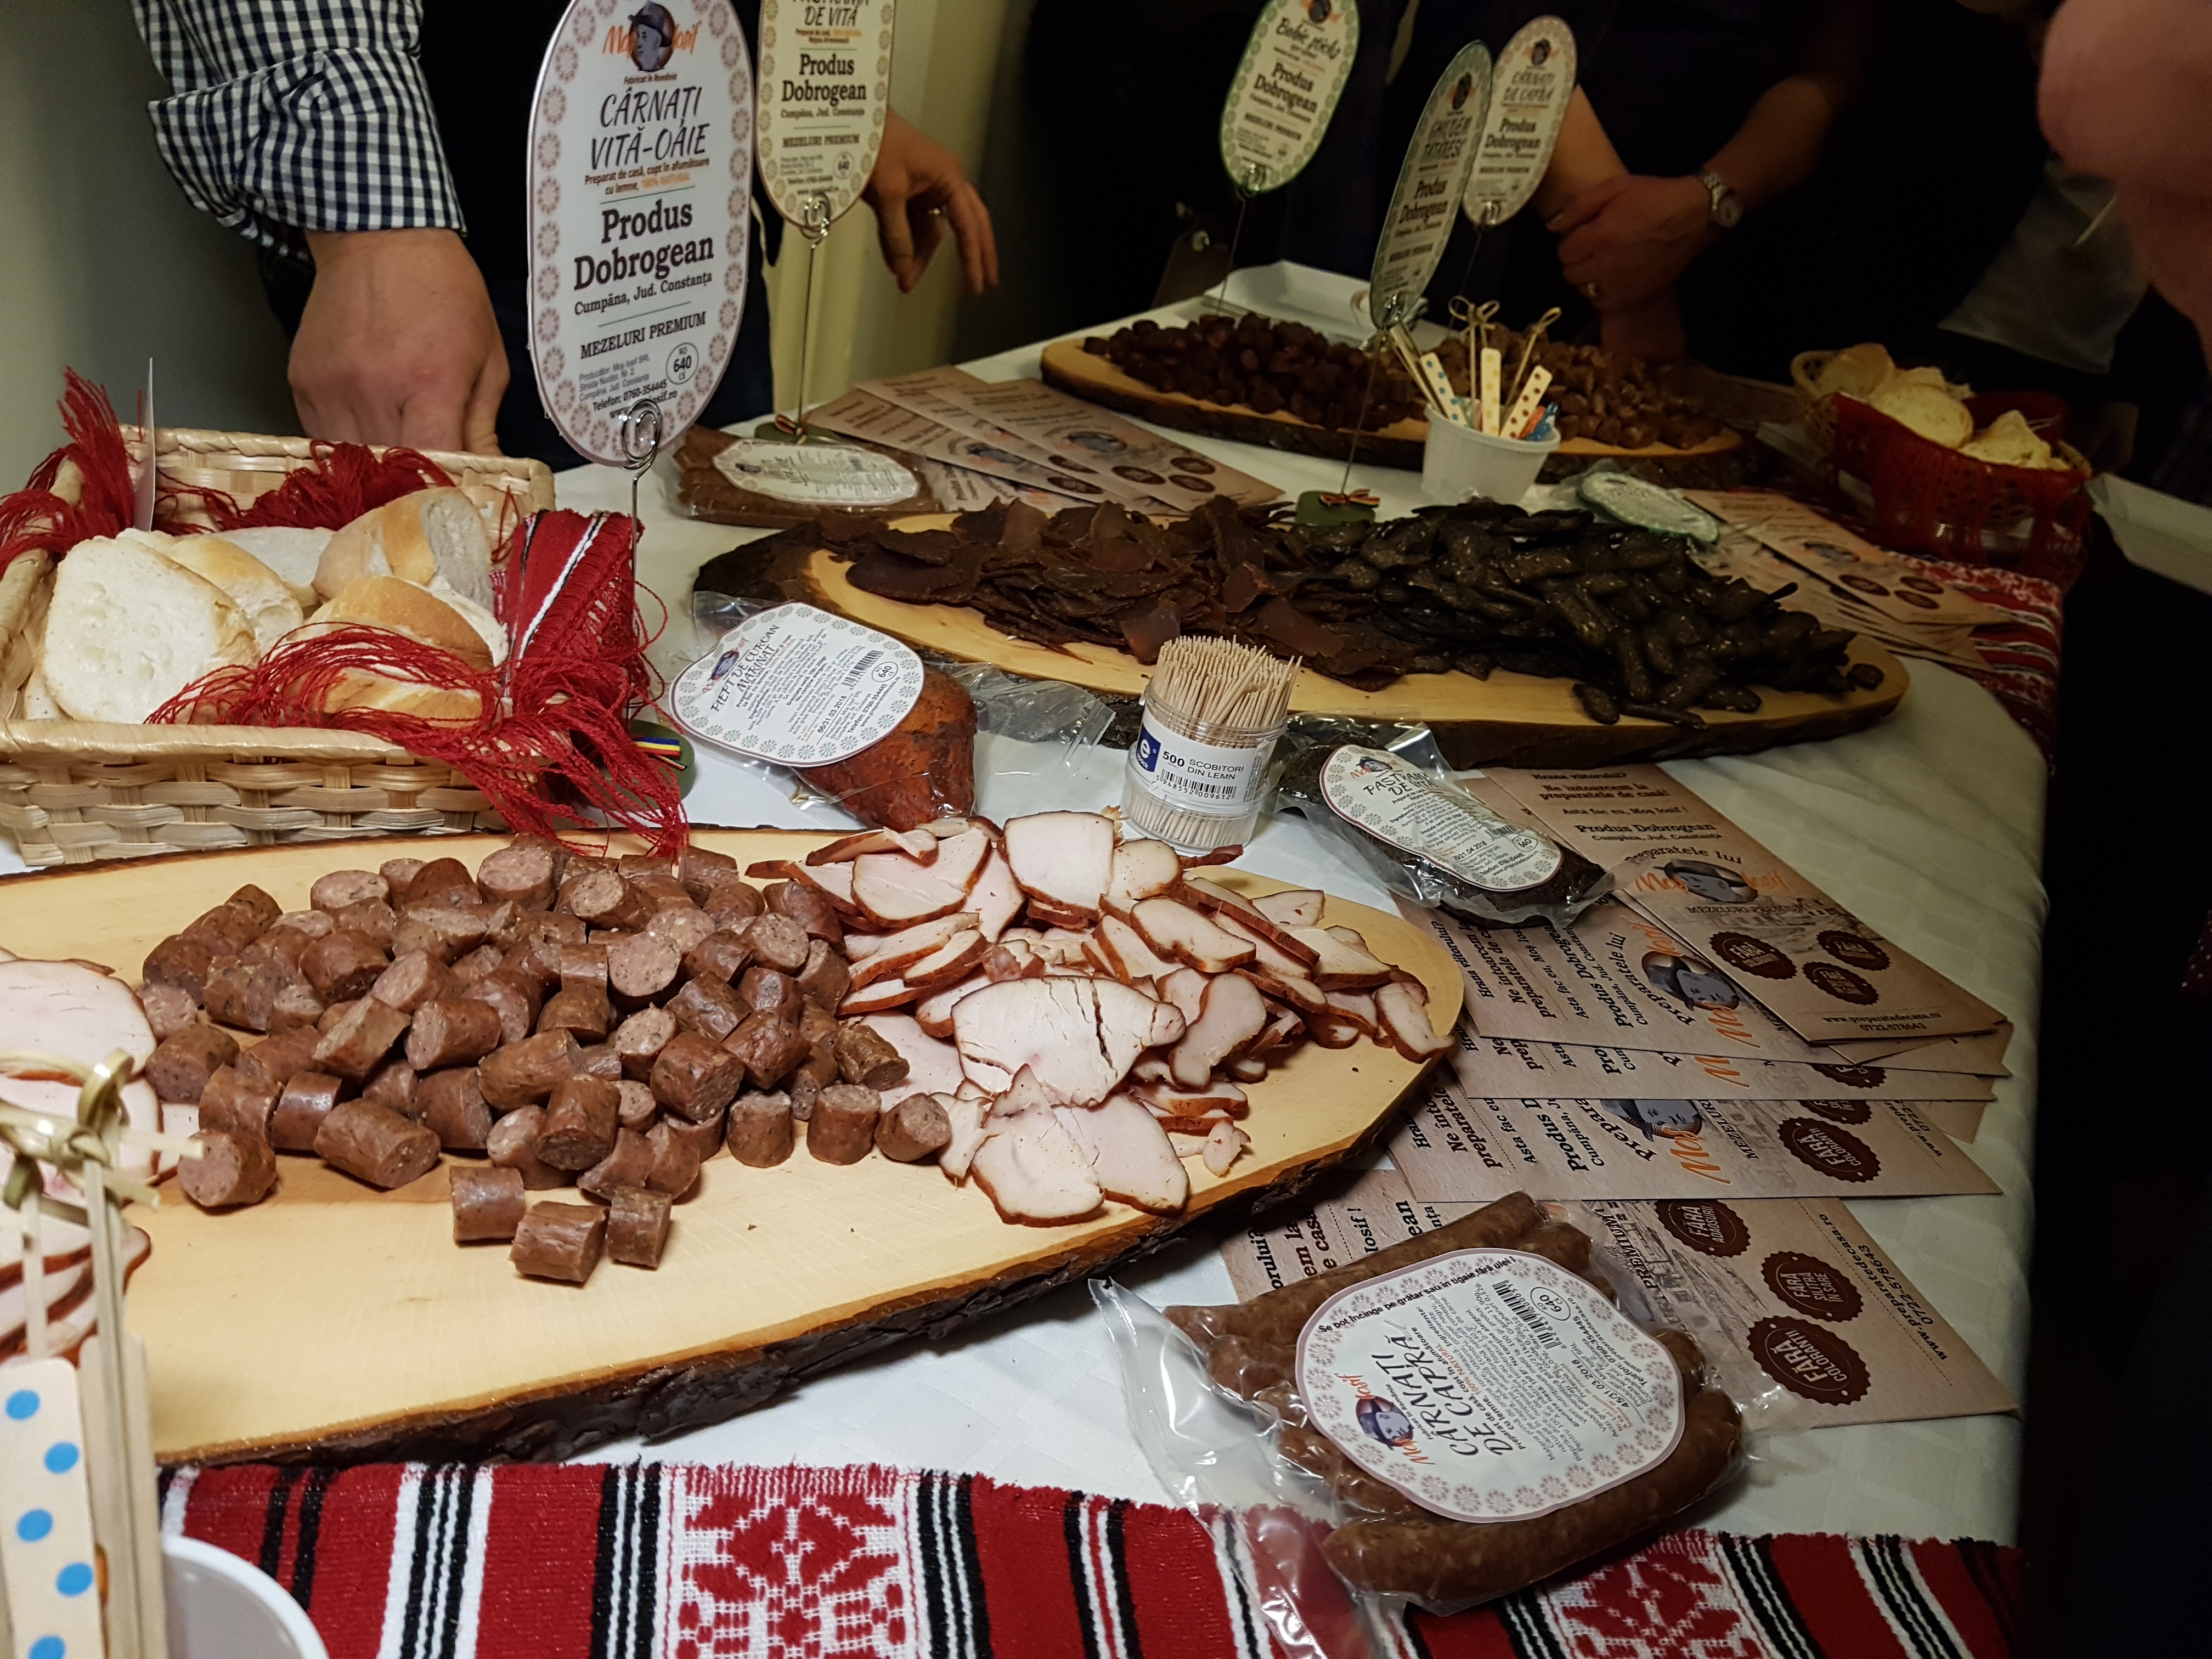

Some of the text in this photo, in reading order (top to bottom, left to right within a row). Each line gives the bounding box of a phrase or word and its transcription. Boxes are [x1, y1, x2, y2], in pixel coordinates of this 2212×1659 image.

[805, 5, 825, 26] DE
[799, 53, 855, 76] Produs
[1272, 62, 1314, 92] Produs
[782, 79, 867, 107] Dobrogean
[1253, 73, 1318, 114] Dobrogean
[1499, 117, 1537, 133] Produs
[592, 123, 710, 170] VITĂ-OAIE
[1485, 133, 1541, 154] Dobrogean
[585, 171, 617, 185] Preparat
[601, 198, 693, 244] Produs
[574, 236, 714, 291] Dobrogean
[634, 283, 657, 300] Jud.
[661, 272, 712, 293] Constanța
[581, 311, 706, 359] MEZELURI PREMIUM
[674, 356, 692, 373] 640
[709, 623, 781, 712] PIEPT DE CURCAN
[732, 644, 778, 692] MARINAT
[877, 665, 892, 678] 640
[817, 695, 847, 733] 66/31.03.2018
[847, 712, 866, 733] Telefon:
[1162, 751, 1185, 767] 500
[1189, 759, 1244, 772] SCOBITORI
[1187, 767, 1205, 776] DIN
[1387, 782, 1411, 796] DE
[1574, 823, 1717, 833] Produs Dobrogean
[1715, 850, 1743, 865] lui
[1431, 921, 1494, 998] Hrana viitorului?
[1487, 941, 1503, 954] de
[1466, 934, 1527, 1005] Ne întoarcem
[1543, 965, 1556, 979] eu,
[1545, 926, 1634, 1028] Produs Dobrogea
[1592, 963, 1613, 981] Jud.
[1606, 932, 1696, 1026] Preparatele lui
[1499, 956, 1557, 1019] preparatele
[1554, 980, 1571, 995] fac
[1567, 997, 1589, 1019] Asta
[1492, 1038, 1513, 1056] Ne
[1434, 1086, 1504, 1169] preparatele
[1497, 1114, 1537, 1164] Asta fac
[1447, 1132, 1469, 1153] Ne
[1537, 1113, 1589, 1173] Produs
[1796, 1133, 1846, 1166] FĂRĂ
[1351, 1216, 1379, 1254] Iosif
[1677, 1206, 1711, 1237] FĂRĂ
[1603, 1214, 1659, 1289] PREMIUM
[1319, 1324, 1332, 1333] Se
[1335, 1319, 1351, 1329] pot
[1350, 1306, 1384, 1323] încinge
[1384, 1301, 1397, 1311] pe
[1398, 1291, 1424, 1306] grătar
[1424, 1286, 1441, 1297] sau
[1494, 1258, 1511, 1271] ulei
[1779, 1272, 1811, 1298] FĂRĂ
[1798, 1272, 1827, 1301] SILITRĂ
[1814, 1272, 1837, 1294] SARE
[1819, 1213, 1948, 1361] www.preparatedecasa.ro
[1858, 1244, 1933, 1325] 0722-578643
[1537, 1294, 1564, 1313] 640
[1426, 1311, 1461, 1345] condimente
[1463, 1307, 1491, 1332] alergeni.
[1407, 1326, 1449, 1366] afumătoare
[1469, 1332, 1483, 1342] 140
[1487, 1331, 1512, 1355] conține
[1566, 1297, 1643, 1373] www.preparatedecasa.ro
[1413, 1306, 1516, 1417] de Ingrediente:
[1432, 1343, 1468, 1375] NATURAL
[1506, 1356, 1520, 1366] Nu
[1570, 1315, 1650, 1387] Telefon: 0760-354445
[1770, 1339, 1829, 1383] FĂRĂ
[1334, 1373, 1376, 1400] Iosif
[1450, 1375, 1471, 1393] copt
[1524, 1375, 1538, 1385] 150
[1370, 1355, 1476, 1454] CÂRNAȚI
[1383, 1335, 1514, 1455] DE CAPRĂ
[1465, 1393, 1489, 1412] casă,
[1479, 1395, 1507, 1420] lemne,
[1483, 1412, 1497, 1421] de
[1503, 1420, 1515, 1430] cu
[1549, 1417, 1564, 1428] 100
[1550, 1402, 1581, 1427] Greutate
[1410, 1417, 1434, 1440] Fabricat
[1492, 1421, 1527, 1449] Preparat
